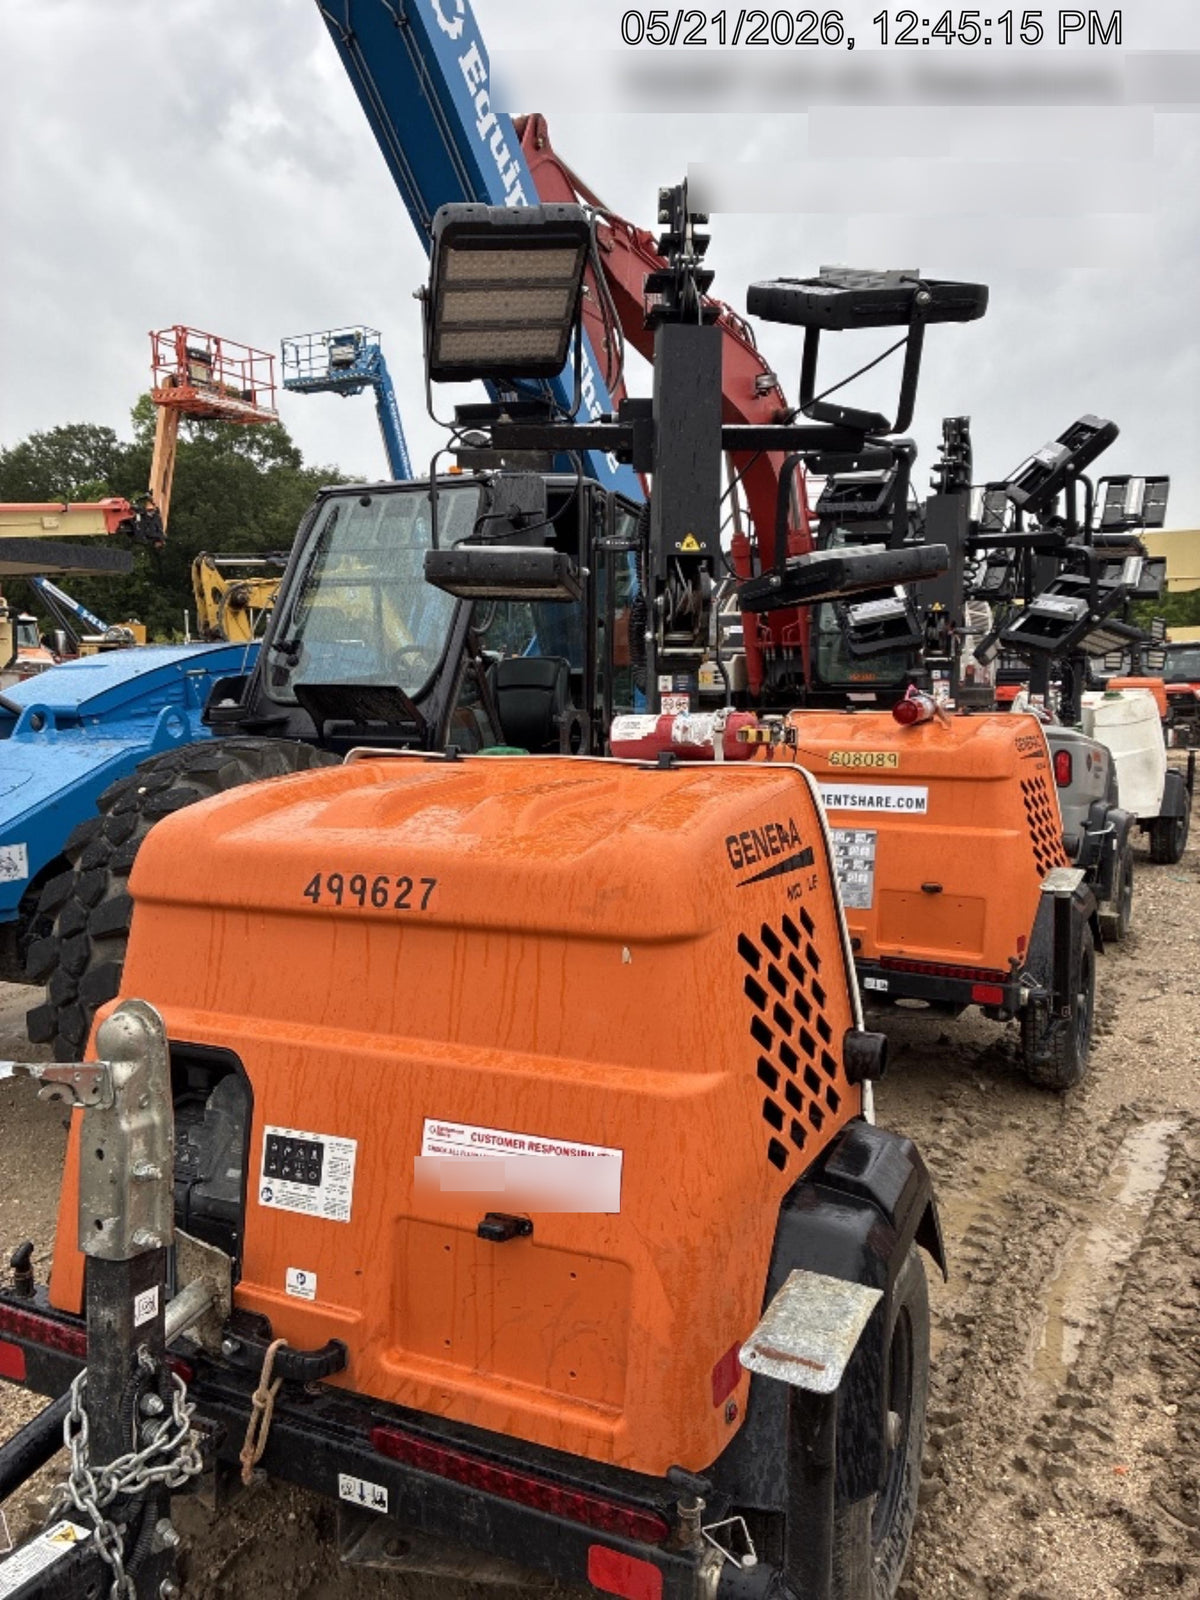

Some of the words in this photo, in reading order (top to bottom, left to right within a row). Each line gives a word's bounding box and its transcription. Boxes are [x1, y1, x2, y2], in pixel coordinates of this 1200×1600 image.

[829, 751, 898, 768] 608089
[303, 872, 438, 911] 499627
[470, 1131, 525, 1150] CUSTOMER
[527, 1141, 615, 1157] RESPONSI
